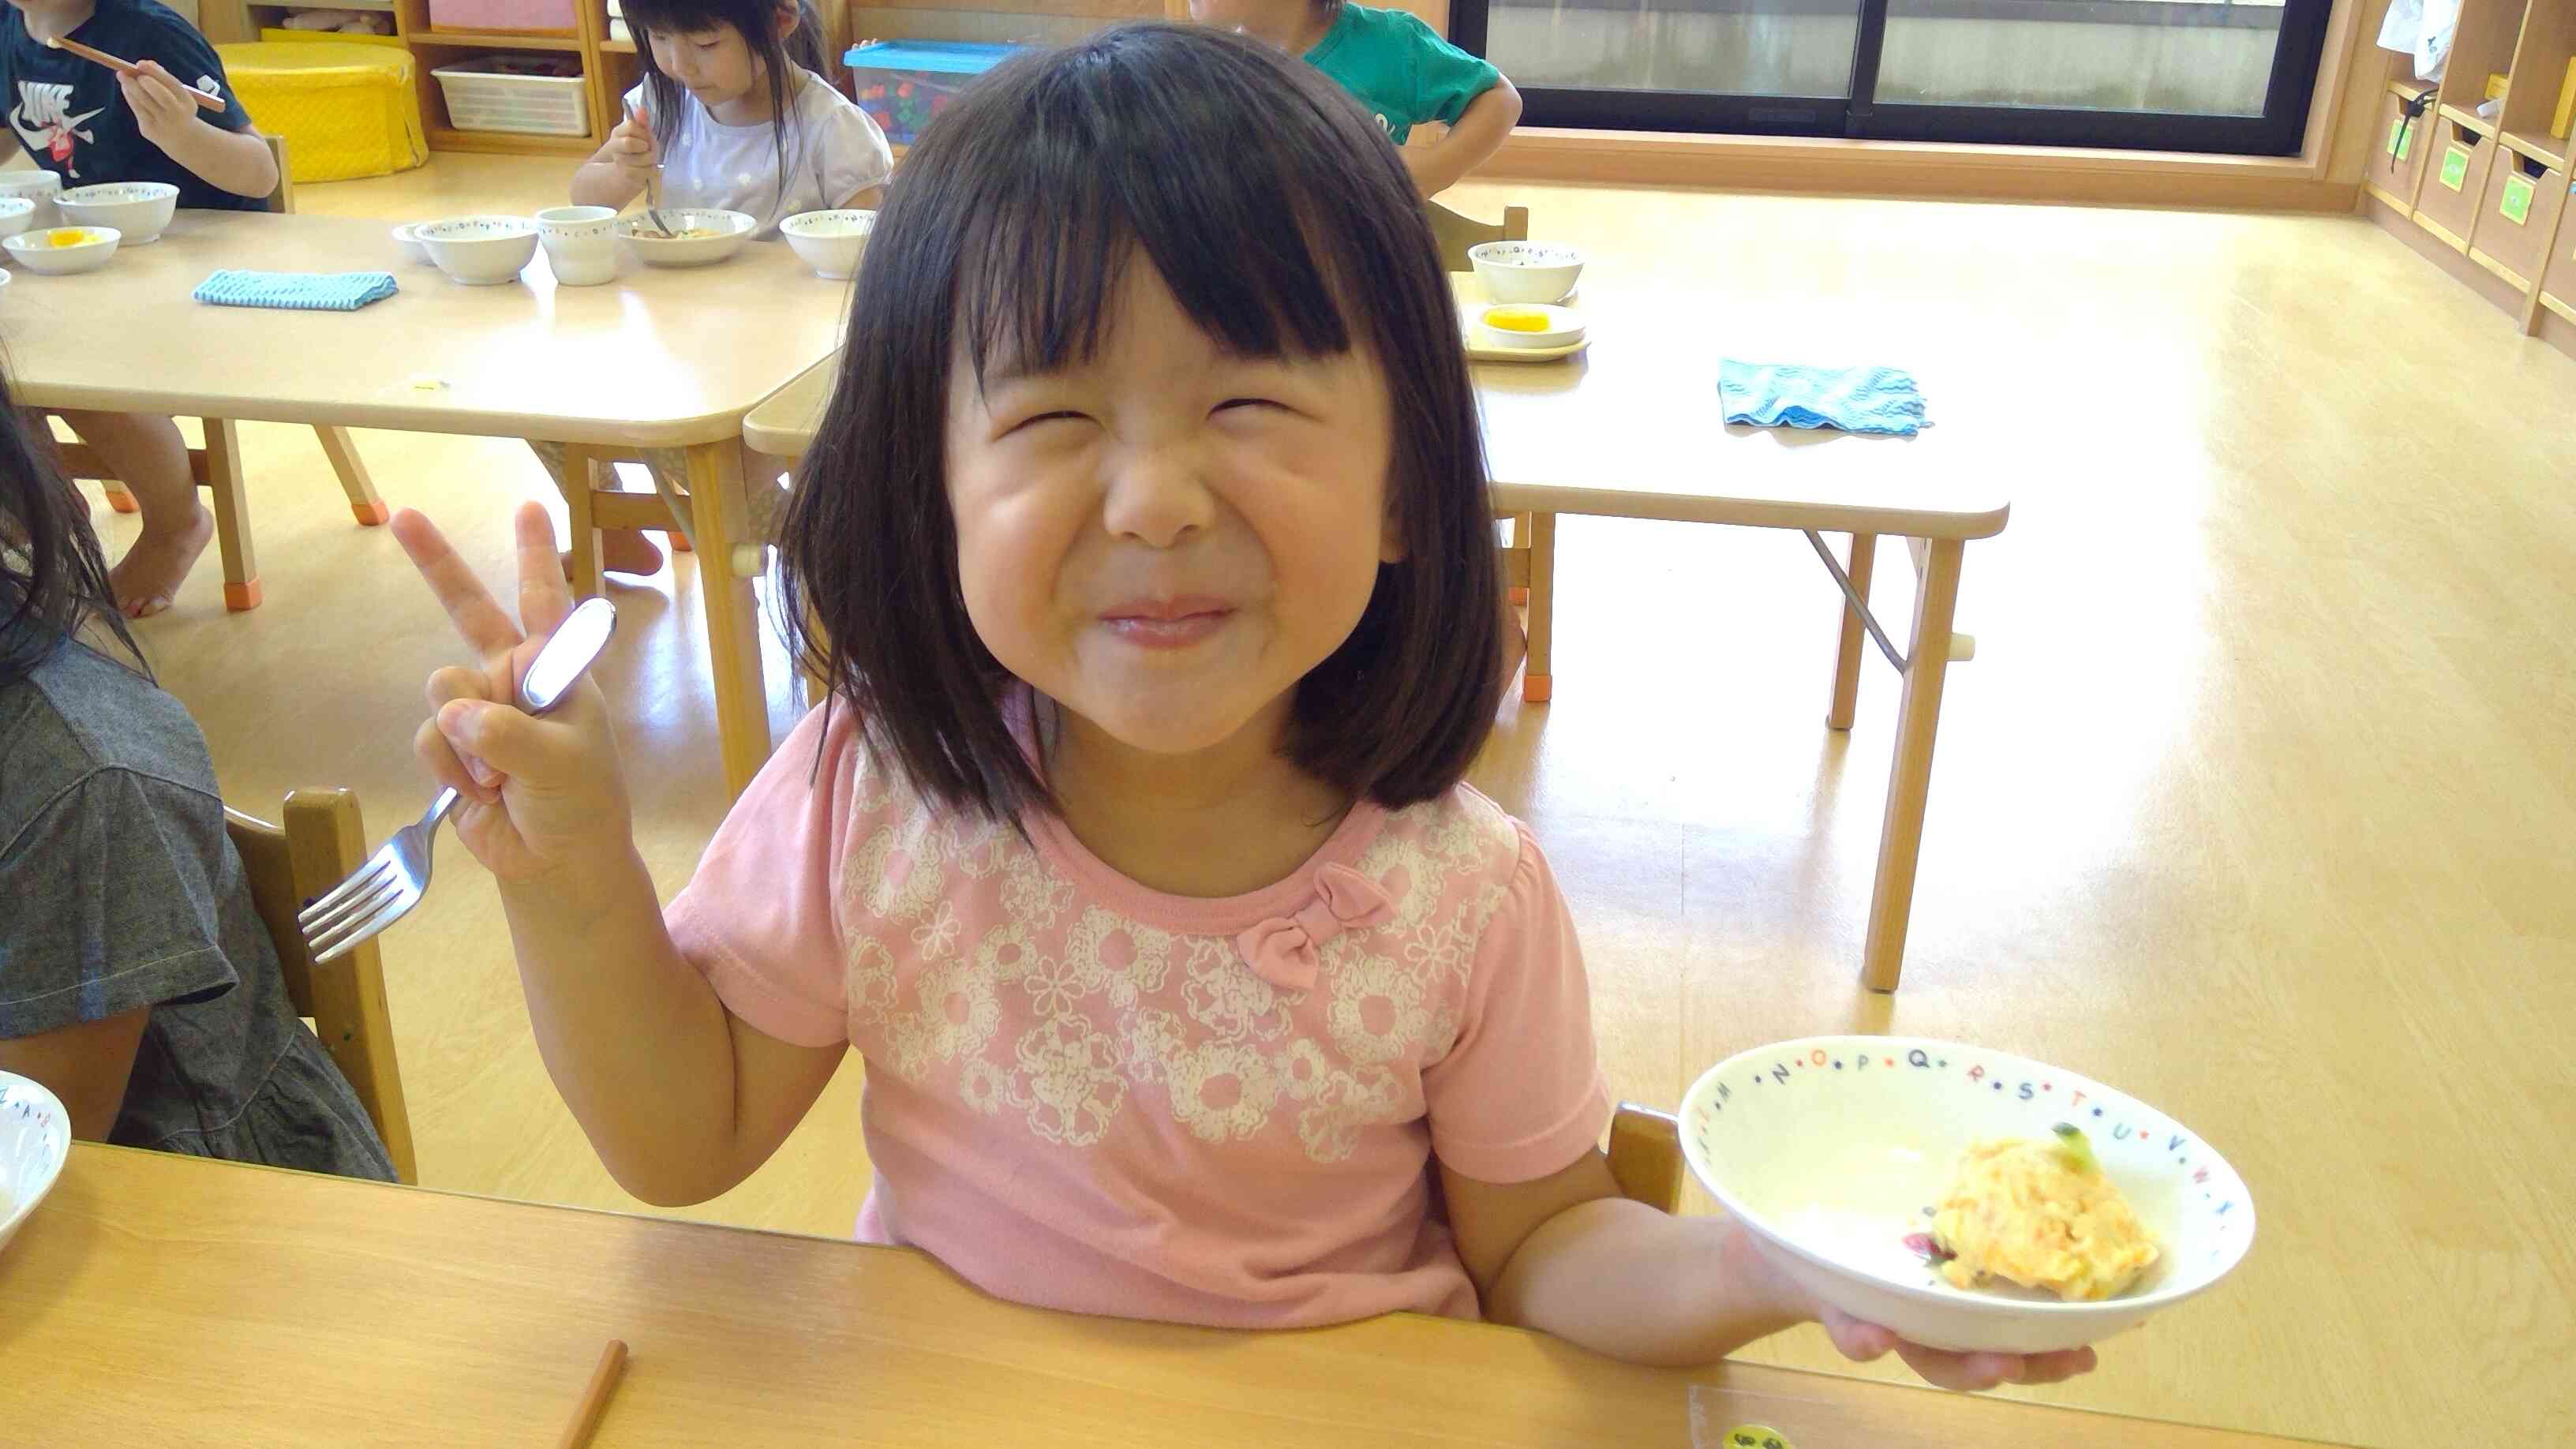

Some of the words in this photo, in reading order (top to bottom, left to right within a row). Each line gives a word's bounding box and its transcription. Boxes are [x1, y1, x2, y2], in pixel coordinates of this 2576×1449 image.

[17, 80, 74, 127] NIKE
[22, 1104, 31, 1118] A
[1772, 1063, 1790, 1085] N
[1811, 1049, 1827, 1067] O
[1858, 1054, 1869, 1071] P
[1908, 1049, 1930, 1069] Q
[1967, 1065, 1984, 1082] R
[2018, 1082, 2035, 1101] S
[2072, 1089, 2087, 1106] T
[2113, 1122, 2132, 1140] U
[2168, 1135, 2187, 1151] V
